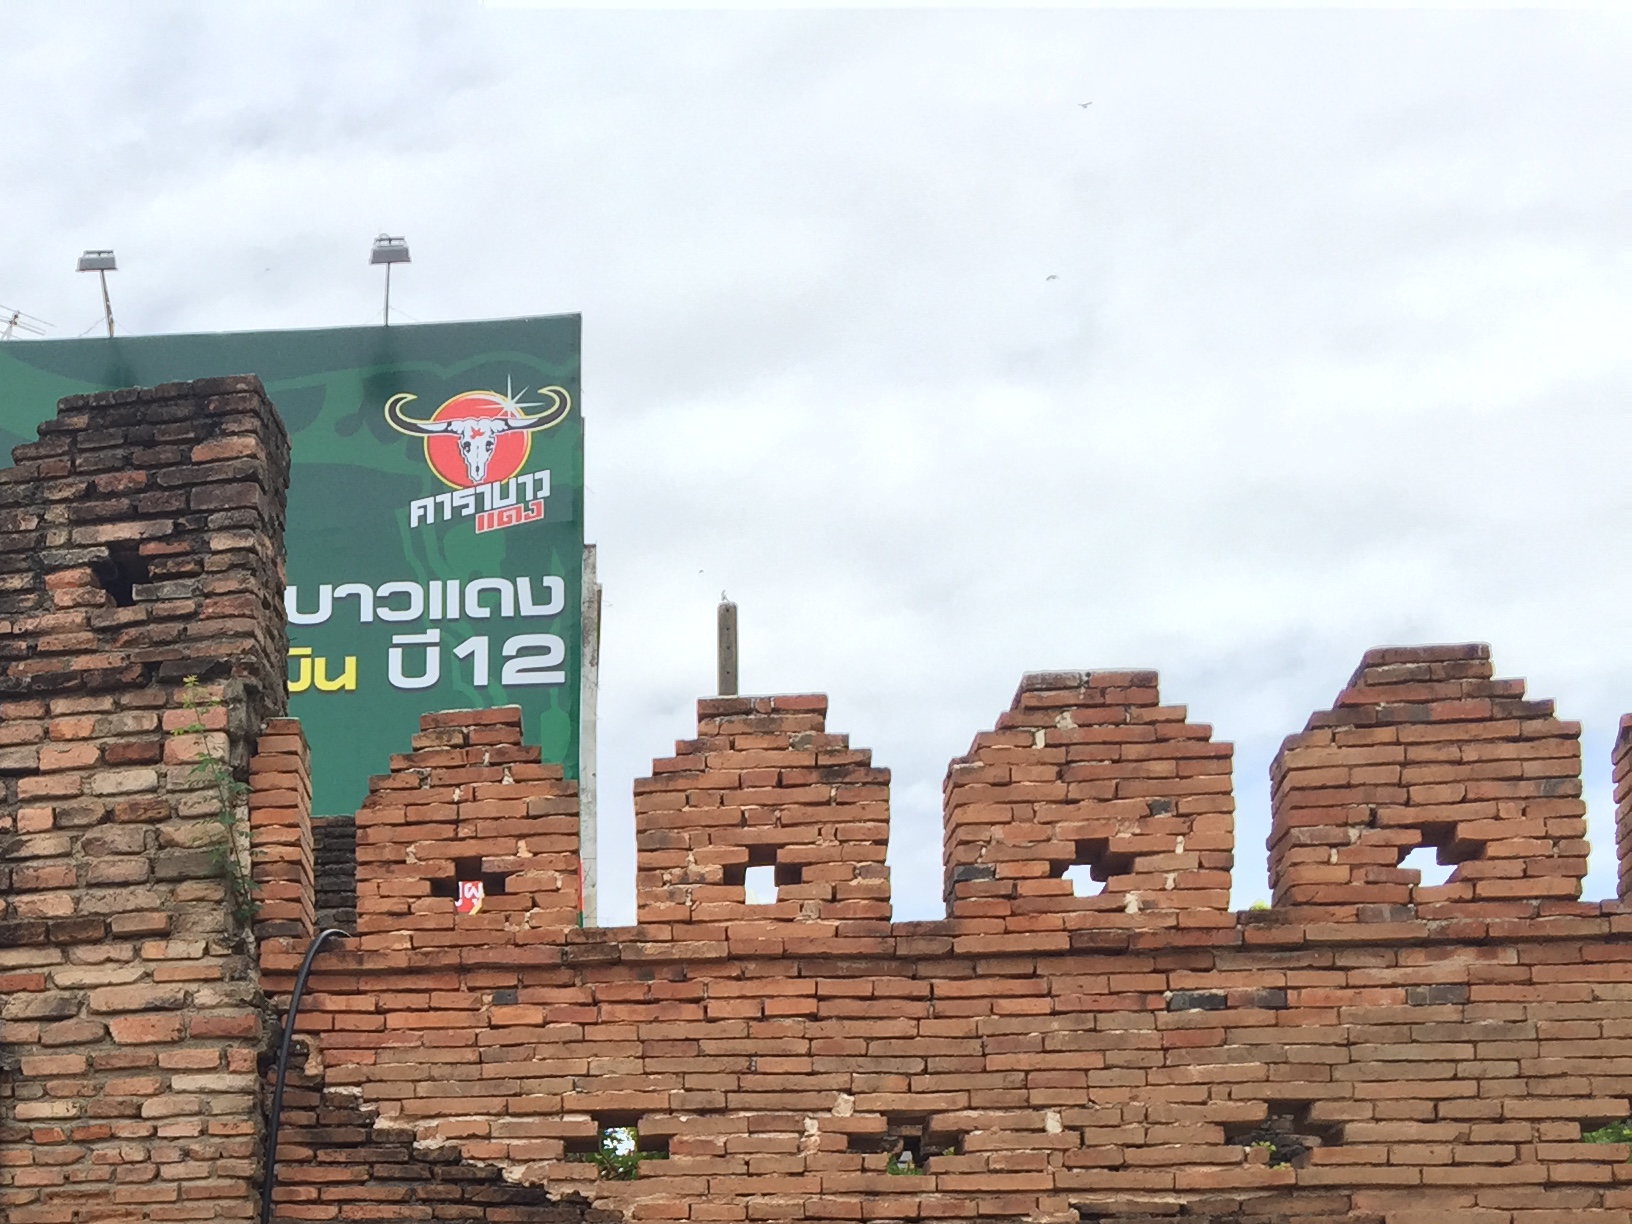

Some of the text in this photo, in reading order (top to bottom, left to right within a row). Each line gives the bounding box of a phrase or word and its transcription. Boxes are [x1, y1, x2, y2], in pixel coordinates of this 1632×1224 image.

[410, 469, 551, 528] คาราบาว
[475, 499, 545, 534] แดง
